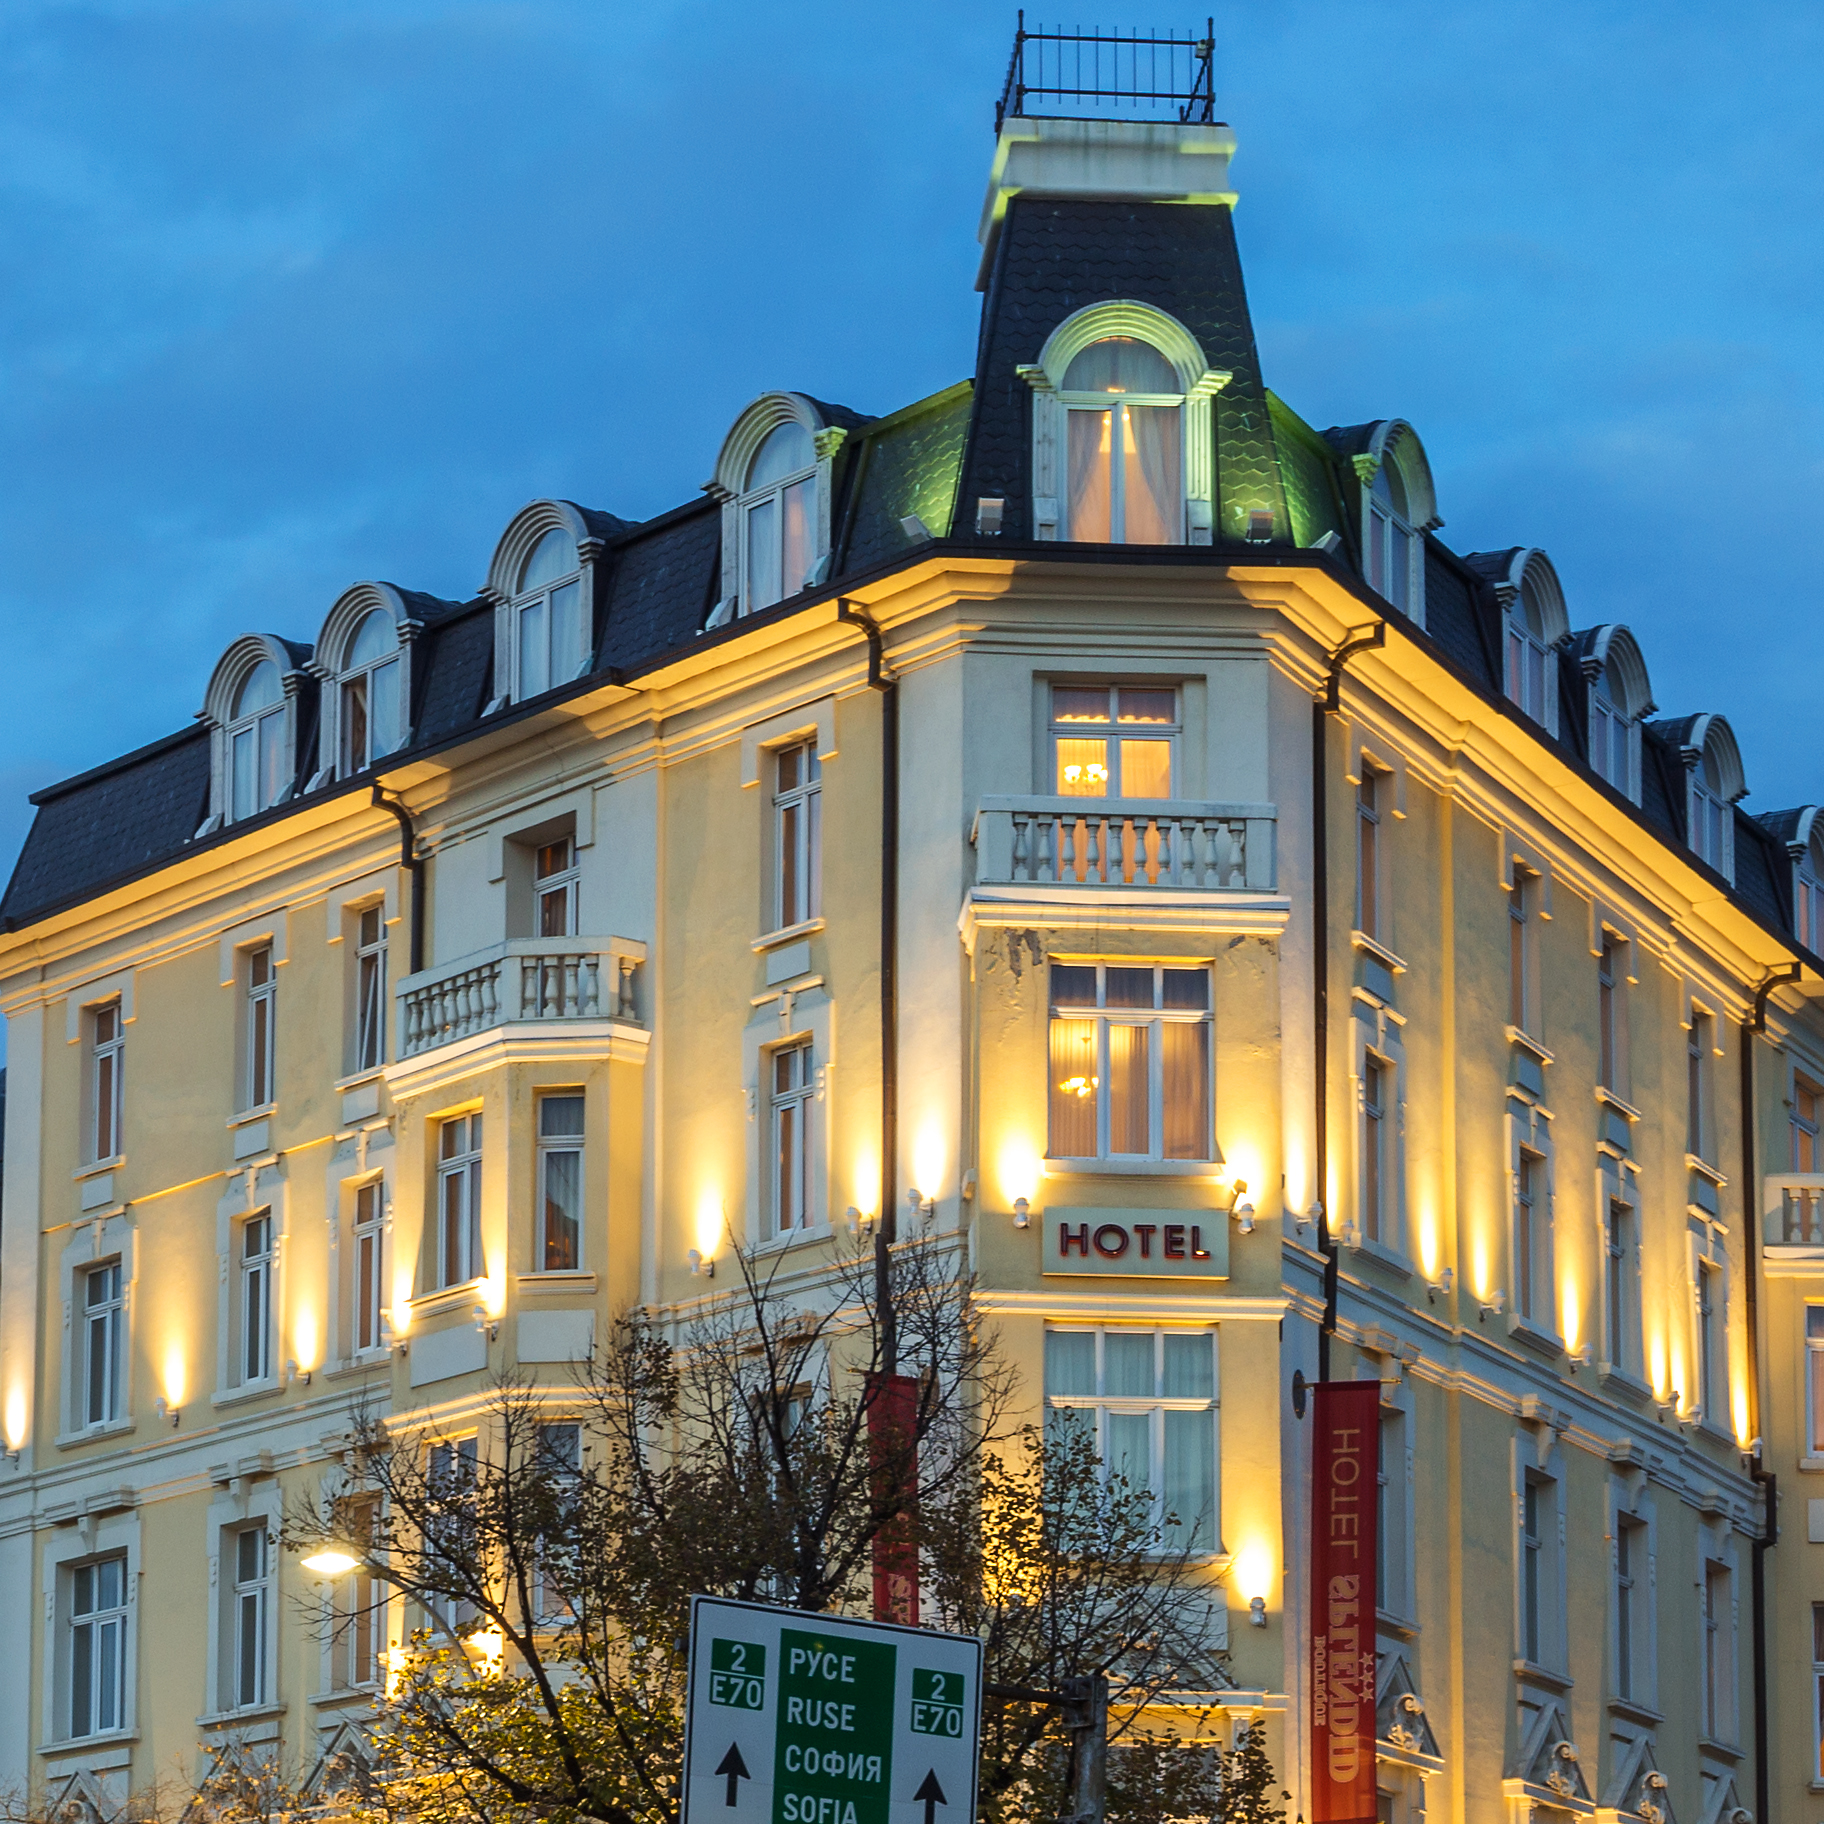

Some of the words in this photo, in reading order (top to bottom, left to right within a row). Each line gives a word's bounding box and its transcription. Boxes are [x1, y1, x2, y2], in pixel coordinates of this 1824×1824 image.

[1059, 1222, 1211, 1259] HOTEL
[730, 1644, 747, 1672] 2
[789, 1648, 857, 1683] РУСЕ
[711, 1675, 762, 1708] E70
[931, 1673, 946, 1700] 2
[786, 1696, 856, 1731] RUSE
[912, 1704, 961, 1736] E70
[785, 1744, 882, 1783] СОФИЯ
